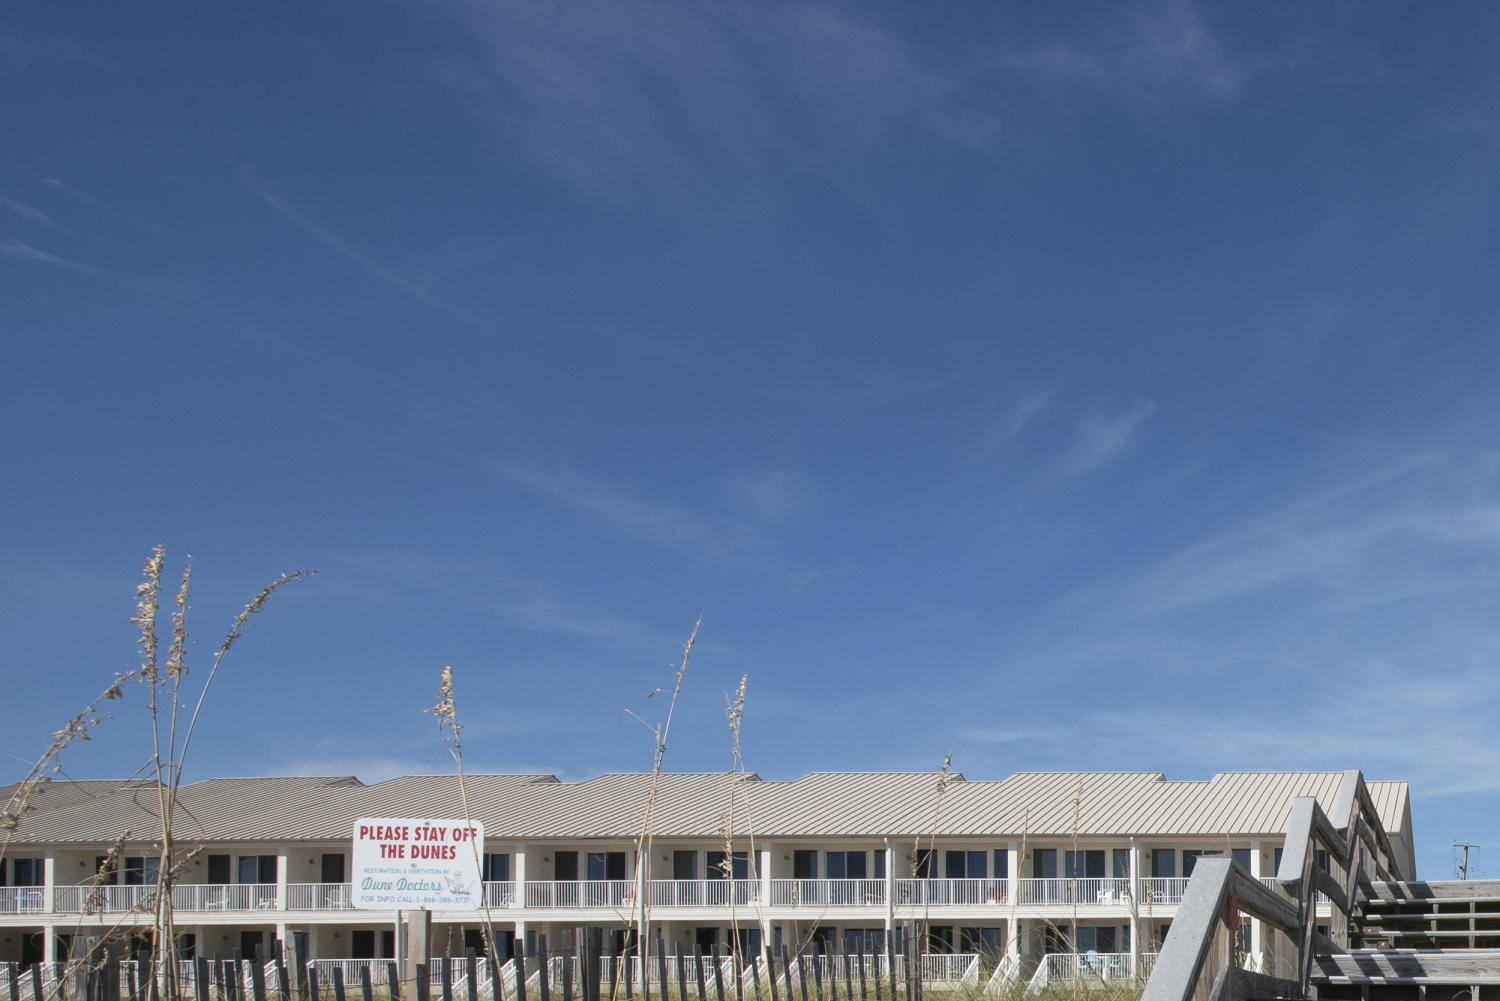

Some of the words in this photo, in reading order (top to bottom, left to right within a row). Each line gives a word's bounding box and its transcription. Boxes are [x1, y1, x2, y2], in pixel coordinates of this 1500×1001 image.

[360, 825, 409, 841] PLEASE
[415, 827, 447, 842] STAY
[452, 828, 477, 842] OFF
[380, 844, 405, 859] THE
[411, 845, 456, 860] DUNES
[361, 876, 392, 891] Dune
[360, 895, 374, 903] FOR
[377, 895, 395, 903] INFO
